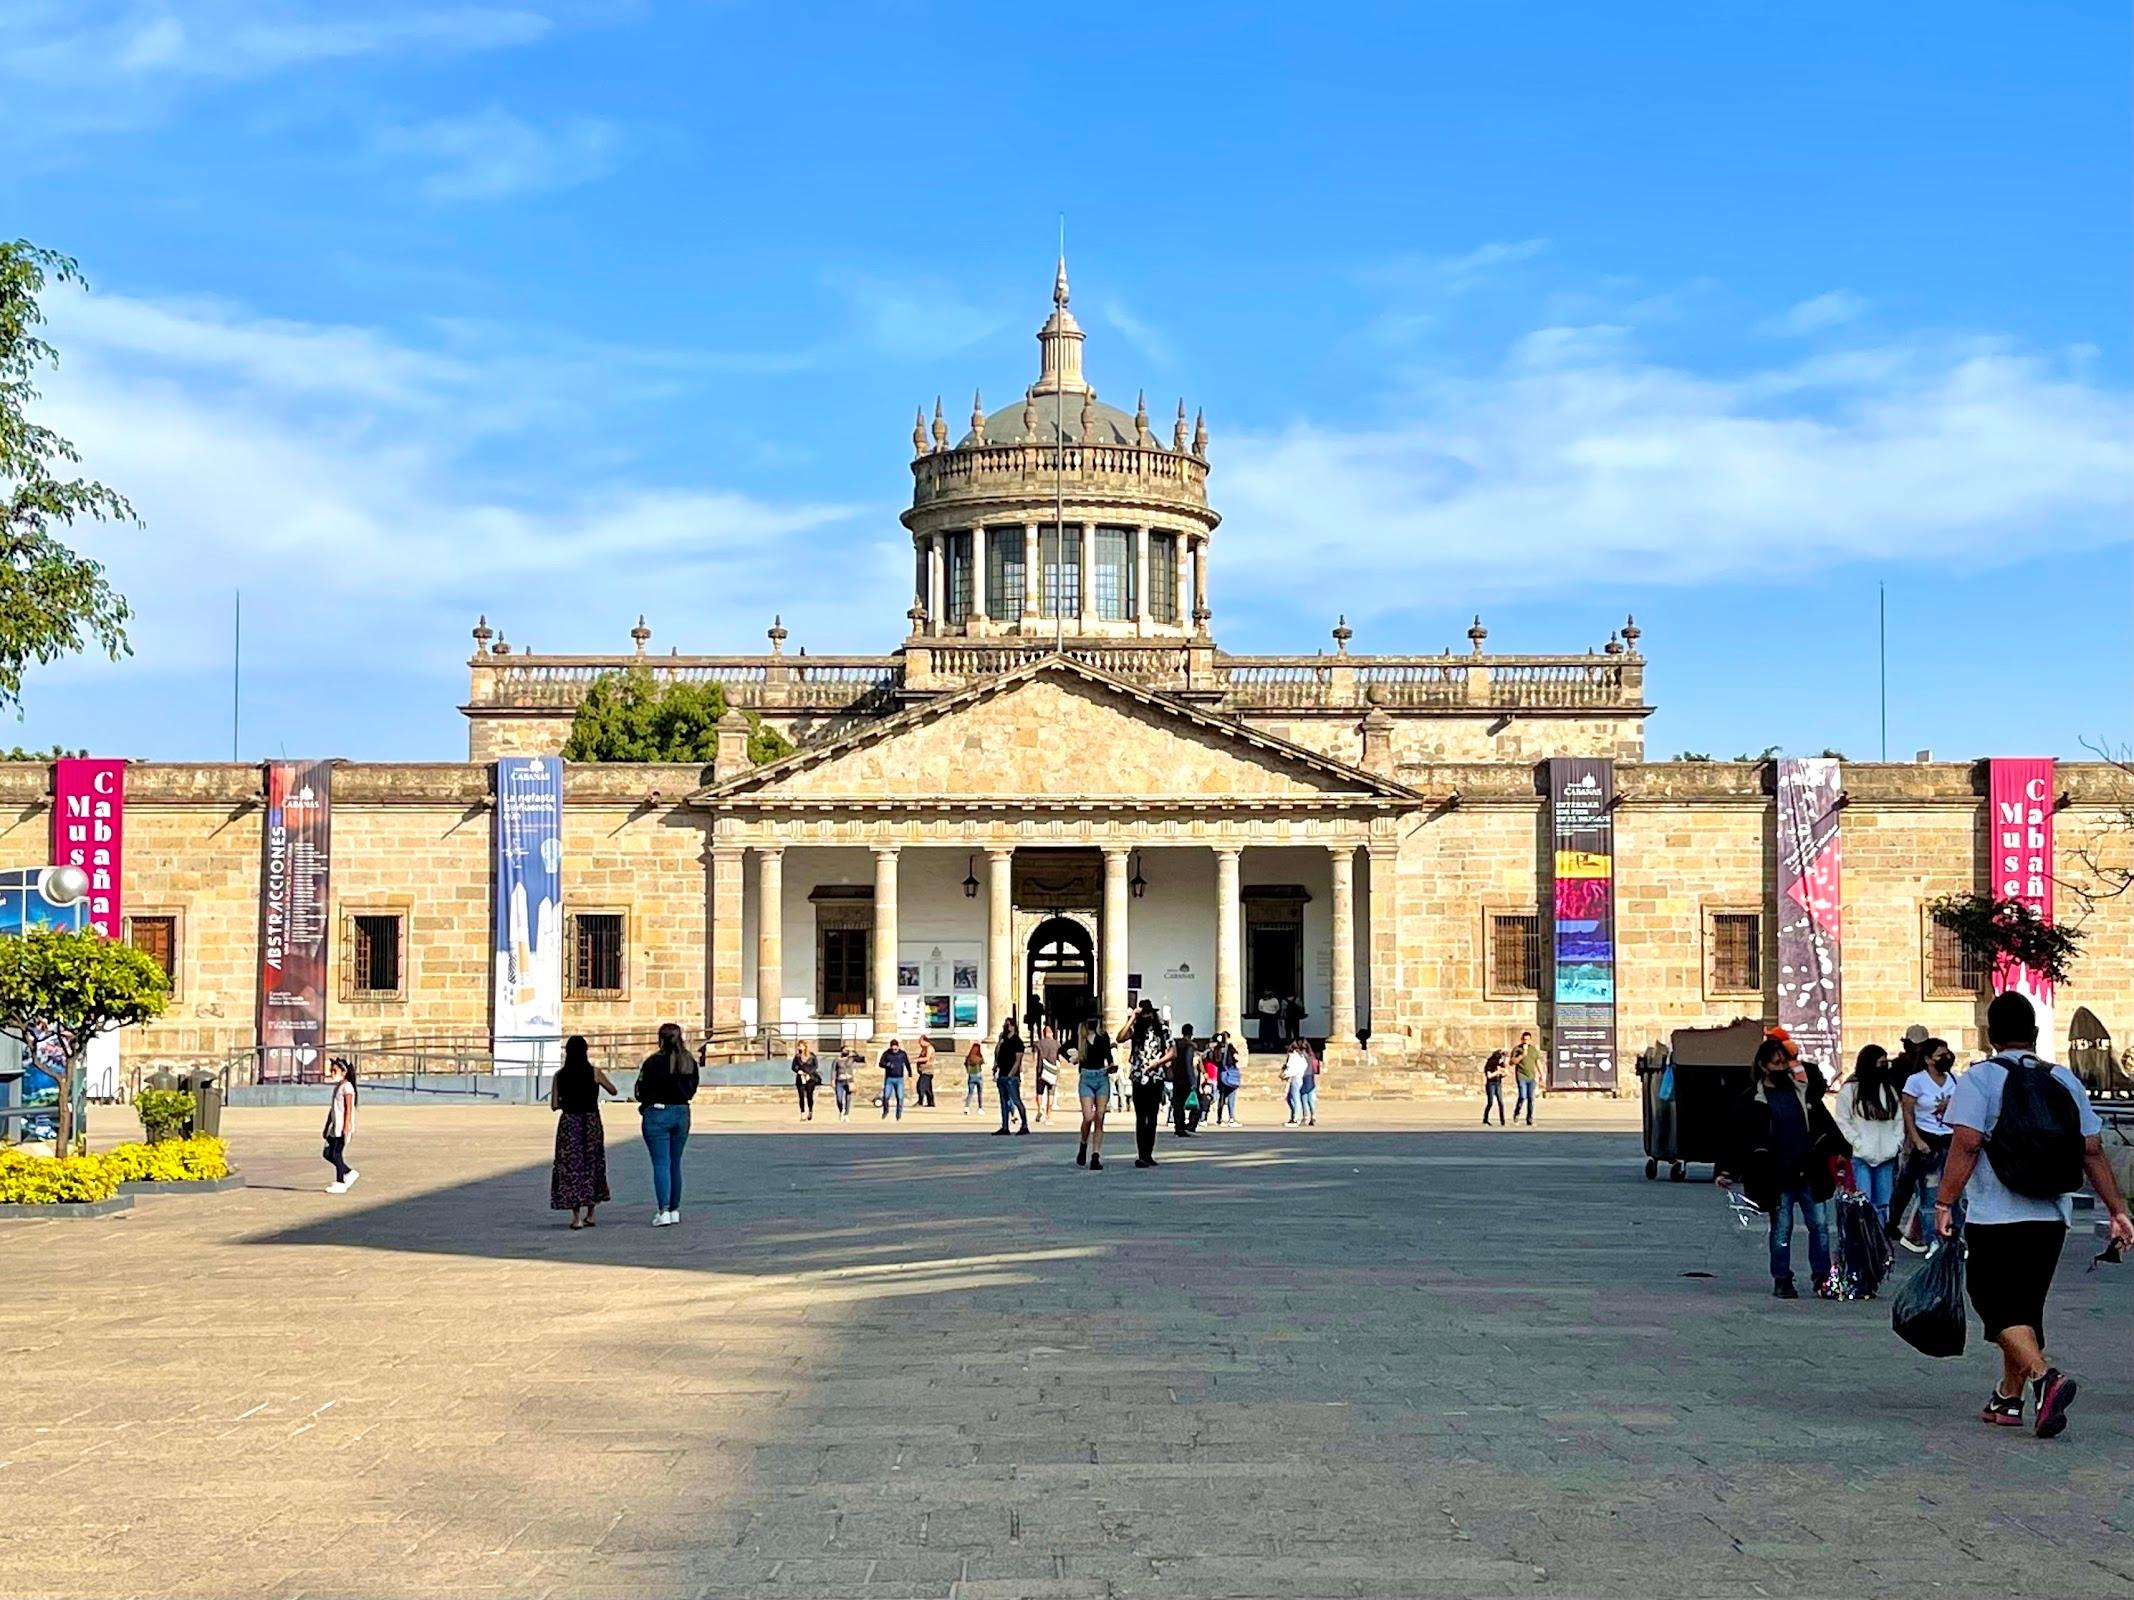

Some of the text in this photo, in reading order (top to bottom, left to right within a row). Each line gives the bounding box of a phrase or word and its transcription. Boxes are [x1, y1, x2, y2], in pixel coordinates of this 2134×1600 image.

[66, 795, 90, 866] Mus
[267, 826, 287, 970] ABSTRACCIONES
[2026, 778, 2045, 921] Cabaña
